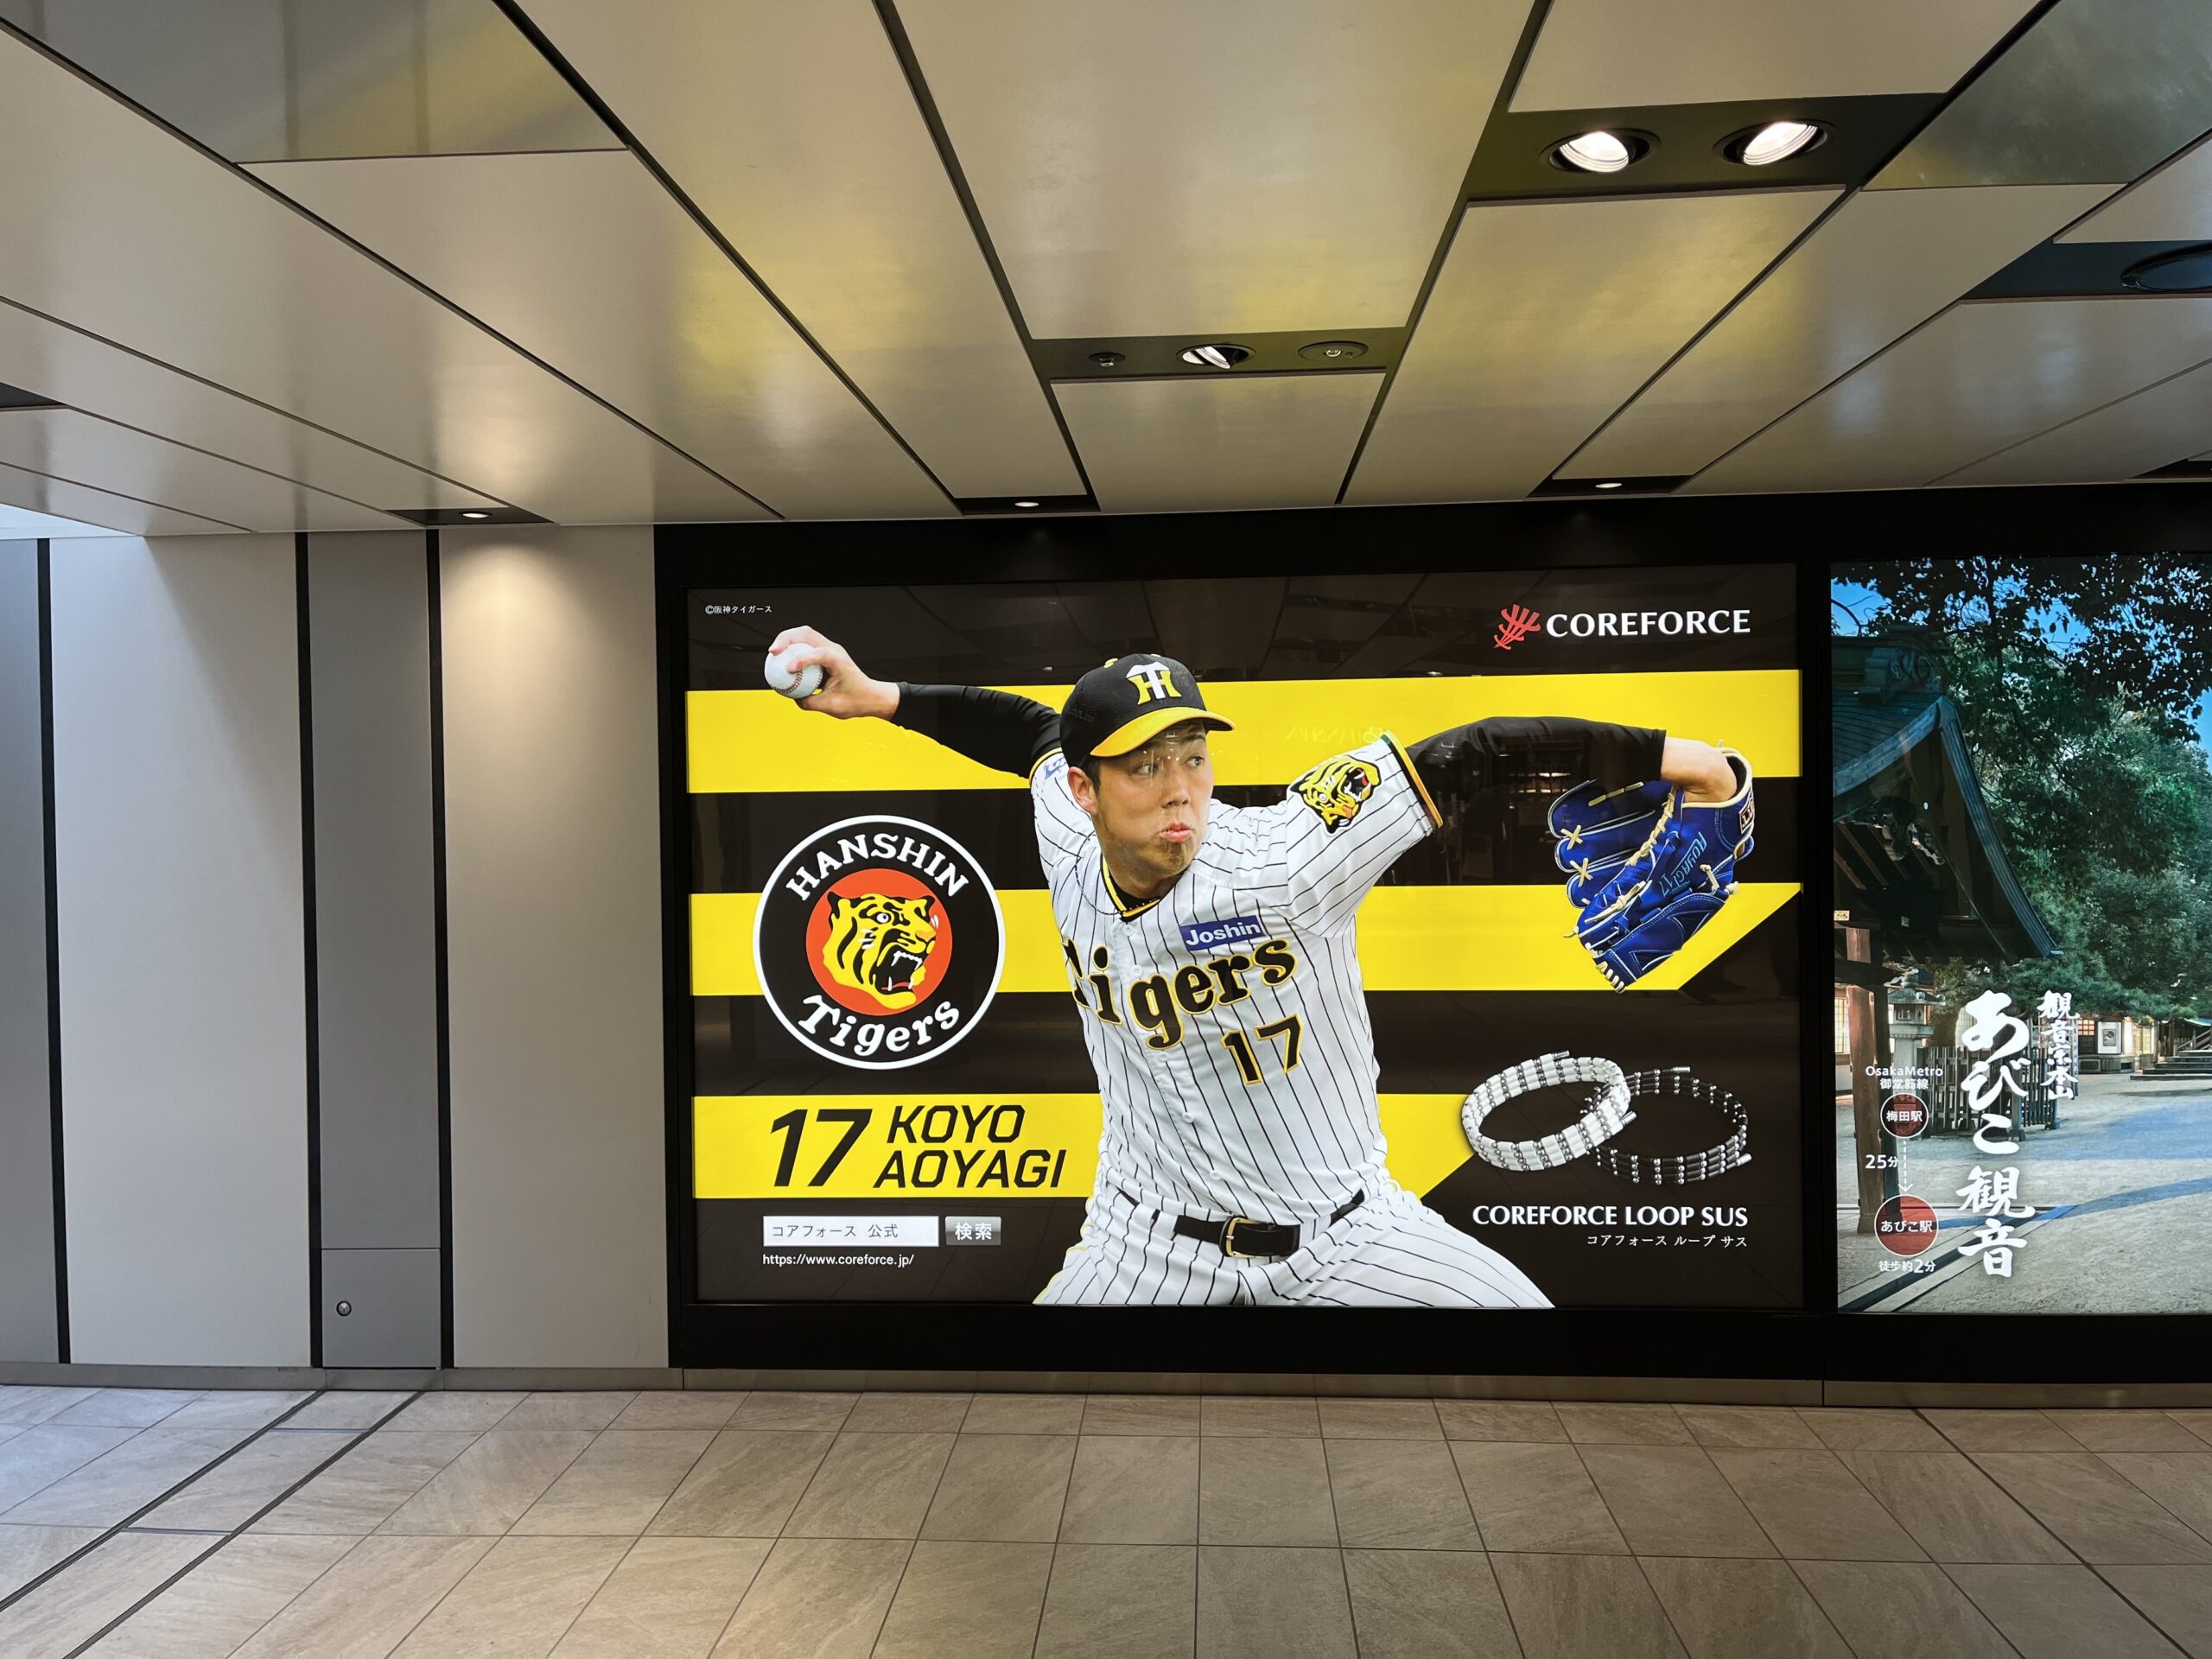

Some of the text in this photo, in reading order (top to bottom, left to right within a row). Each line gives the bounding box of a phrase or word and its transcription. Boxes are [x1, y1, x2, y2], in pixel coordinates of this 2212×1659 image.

[704, 605, 772, 614] ©阪神タイガース
[1547, 610, 1751, 638] COREFORCE
[786, 833, 969, 900] HANSHIN
[1186, 921, 1262, 946] Joshin
[798, 995, 959, 1056] Tigers
[1220, 1013, 1303, 1085] 17
[2037, 989, 2081, 1100] 観音宗本山
[1879, 1077, 1929, 1090] 御堂筋線
[887, 1104, 1026, 1143] KOYO
[1886, 1110, 1923, 1122] 梅田駅
[769, 1109, 873, 1187] 17
[873, 1149, 1067, 1189] AOYAGI
[1472, 1205, 1748, 1227] COREFORCE LOOP SUS
[1881, 1220, 1933, 1233] あびこ駅
[772, 1224, 899, 1238] コアフォース 公式
[955, 1222, 992, 1241] 検索
[1587, 1234, 1747, 1248] コアフォース ループ サス
[762, 1254, 915, 1268] https://www.coreforce.jp/
[1878, 1259, 1936, 1274] 徒歩約2分
